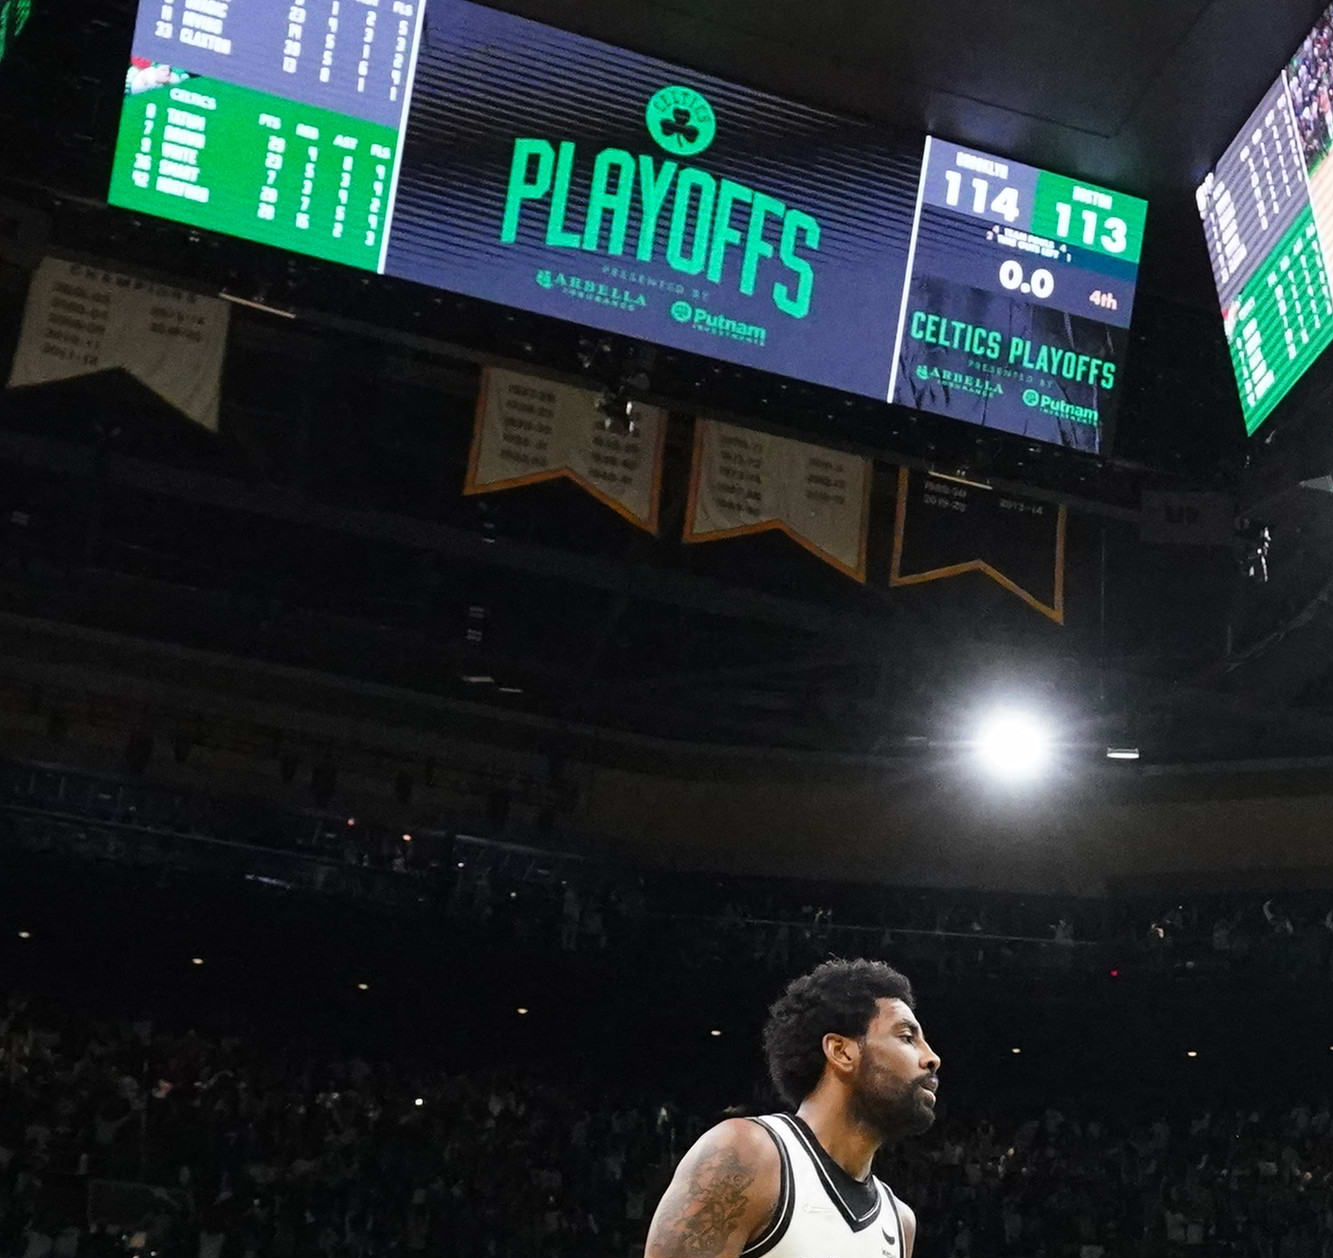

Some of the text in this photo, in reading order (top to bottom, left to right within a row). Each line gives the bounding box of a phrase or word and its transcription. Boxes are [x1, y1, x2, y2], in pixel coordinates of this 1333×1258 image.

[945, 170, 1020, 222] 114
[501, 138, 821, 319] PLAYOFFS
[1056, 202, 1128, 253] 113
[554, 273, 646, 306] ARBELLA
[999, 260, 1055, 298] 0.0
[1089, 290, 1118, 311] 4th
[693, 308, 767, 340] Putnam
[910, 312, 1117, 389] CELTICS PLAYOFFS
[929, 367, 1004, 395] ARBELLA
[1040, 395, 1099, 421] Putnam
